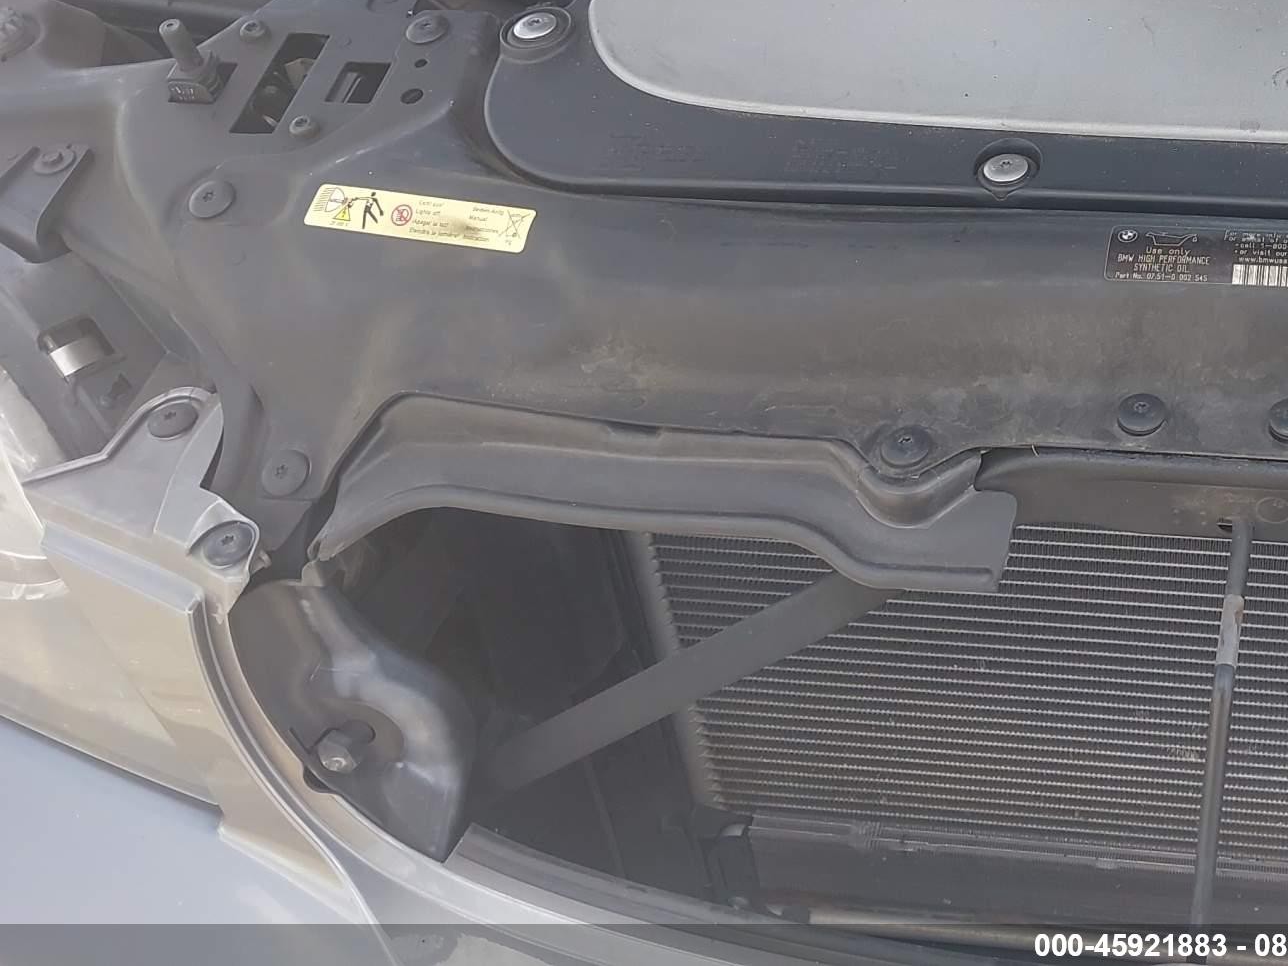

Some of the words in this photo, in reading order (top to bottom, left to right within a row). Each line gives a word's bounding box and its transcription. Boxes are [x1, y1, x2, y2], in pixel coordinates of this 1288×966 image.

[1146, 246, 1163, 254] Use
[1168, 247, 1191, 257] only
[1117, 253, 1135, 263] BMW
[1137, 254, 1156, 263] HIGH
[1158, 254, 1211, 265] PERFORMANCE
[1133, 263, 1174, 272] SYNTHETIC
[1176, 264, 1190, 273] OIL
[1114, 271, 1130, 279] Part
